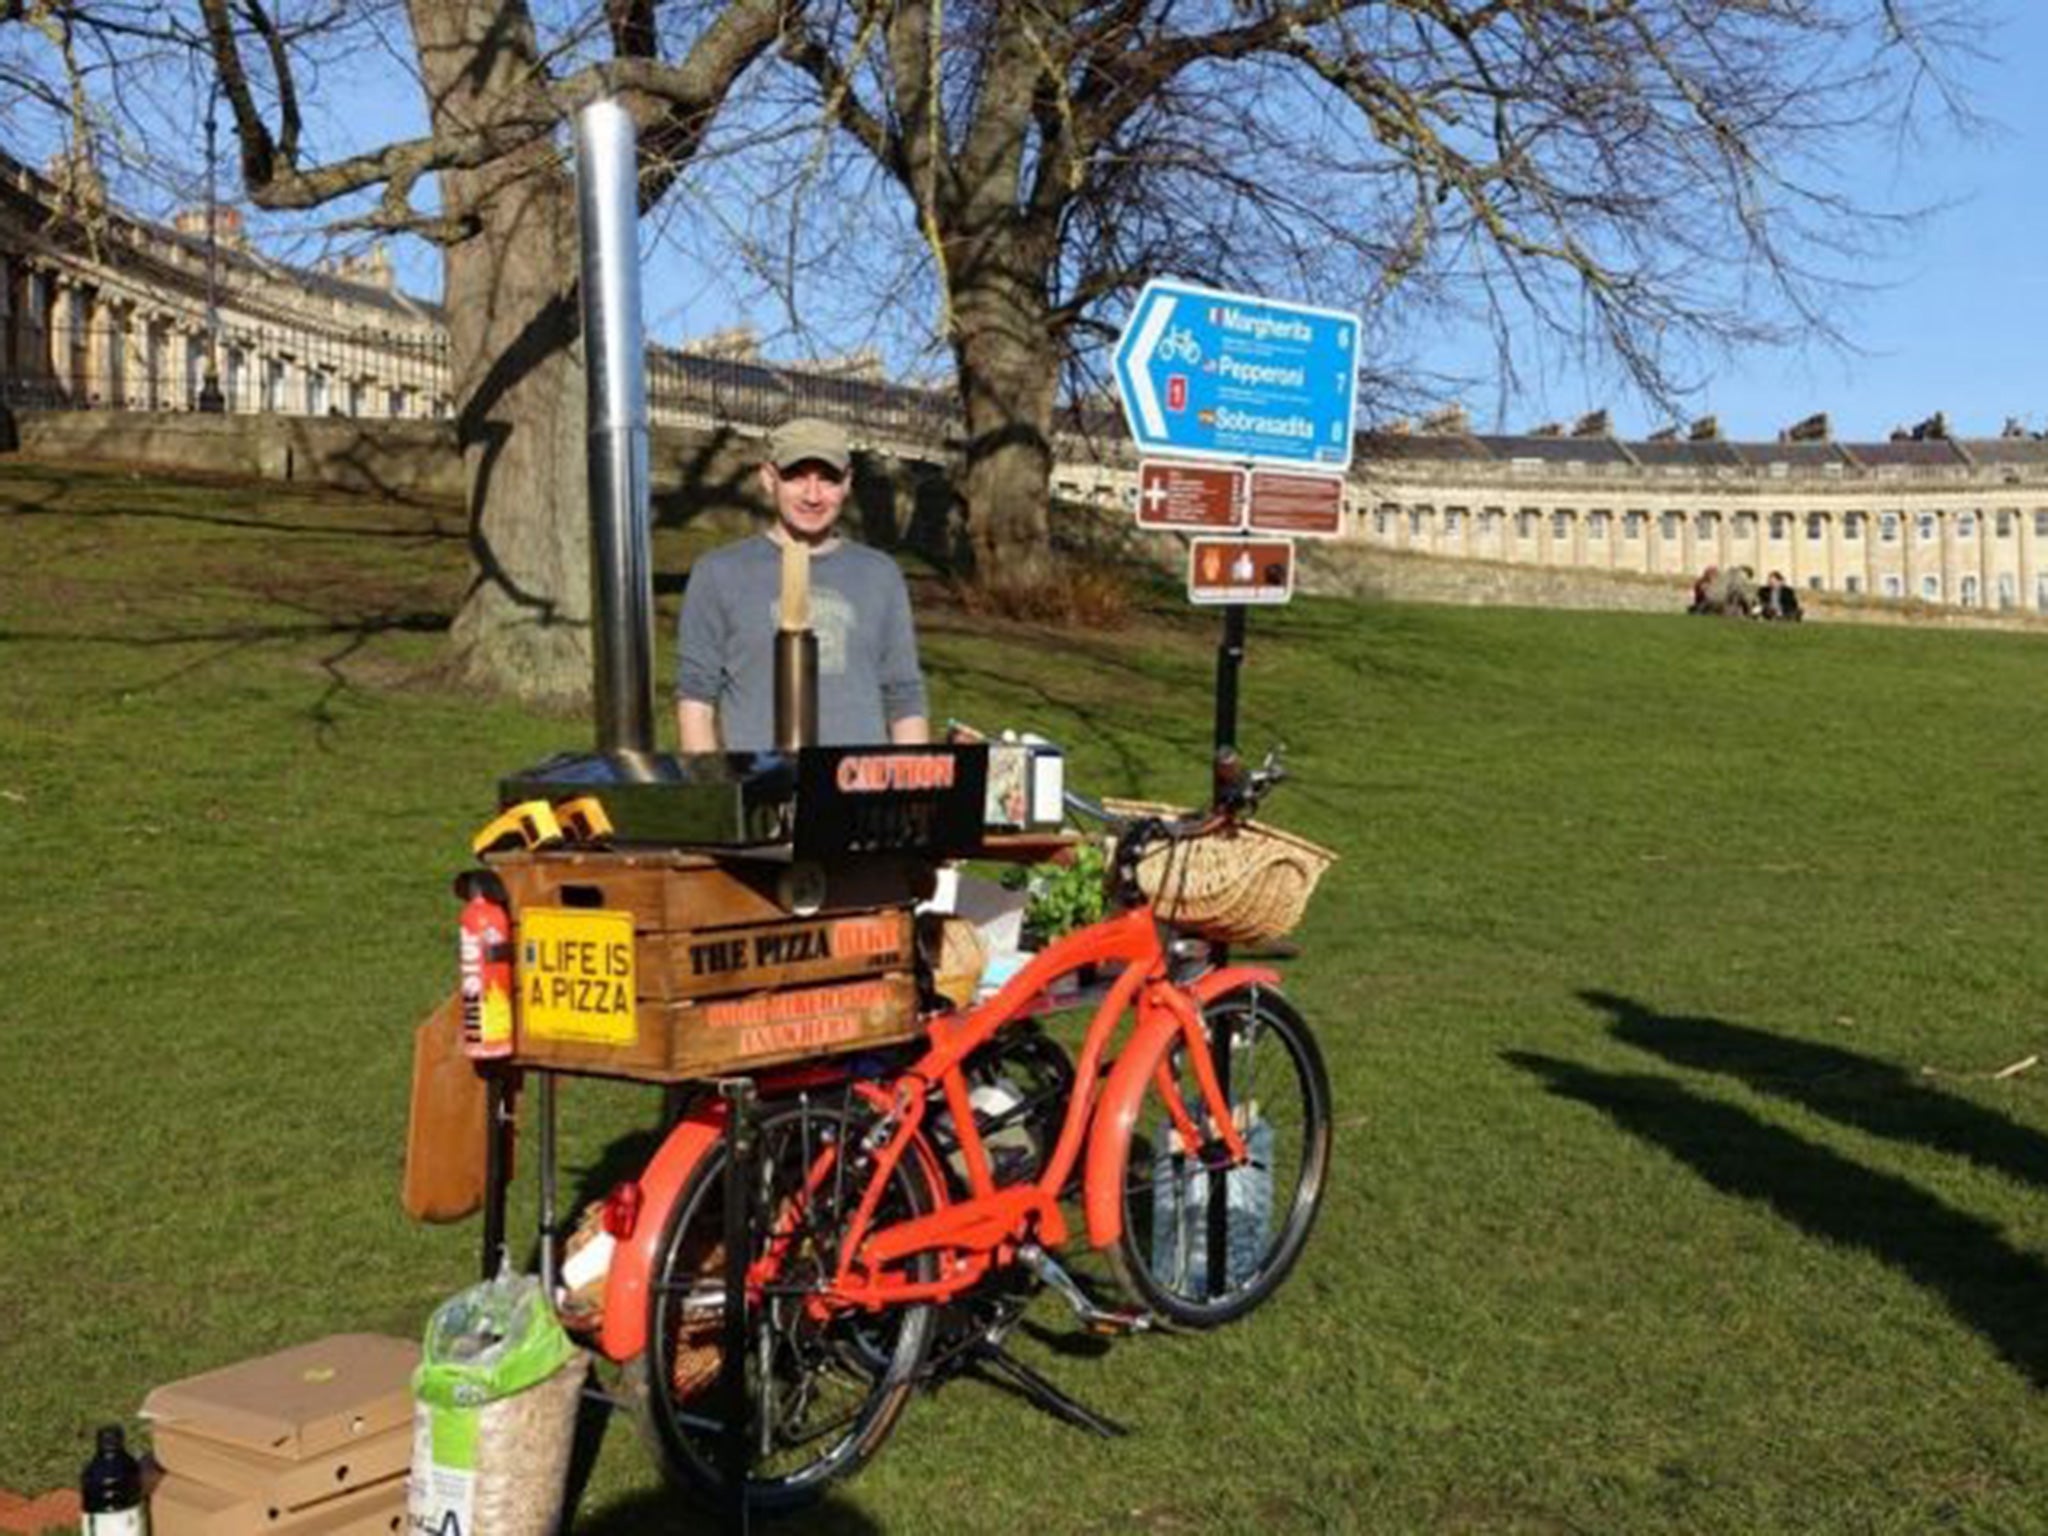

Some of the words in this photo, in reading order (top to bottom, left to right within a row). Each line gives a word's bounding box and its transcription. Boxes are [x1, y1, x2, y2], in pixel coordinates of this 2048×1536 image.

[1223, 308, 1312, 341] Margherita
[1219, 355, 1304, 387] Pepperoni
[1336, 372, 1346, 395] 7
[837, 754, 955, 792] CAUTION
[539, 940, 598, 975] LIFE
[606, 943, 629, 976] IS
[690, 939, 747, 975] THE
[755, 927, 831, 966] PIZZA
[530, 977, 545, 1006] A
[553, 977, 629, 1014] PIZZA
